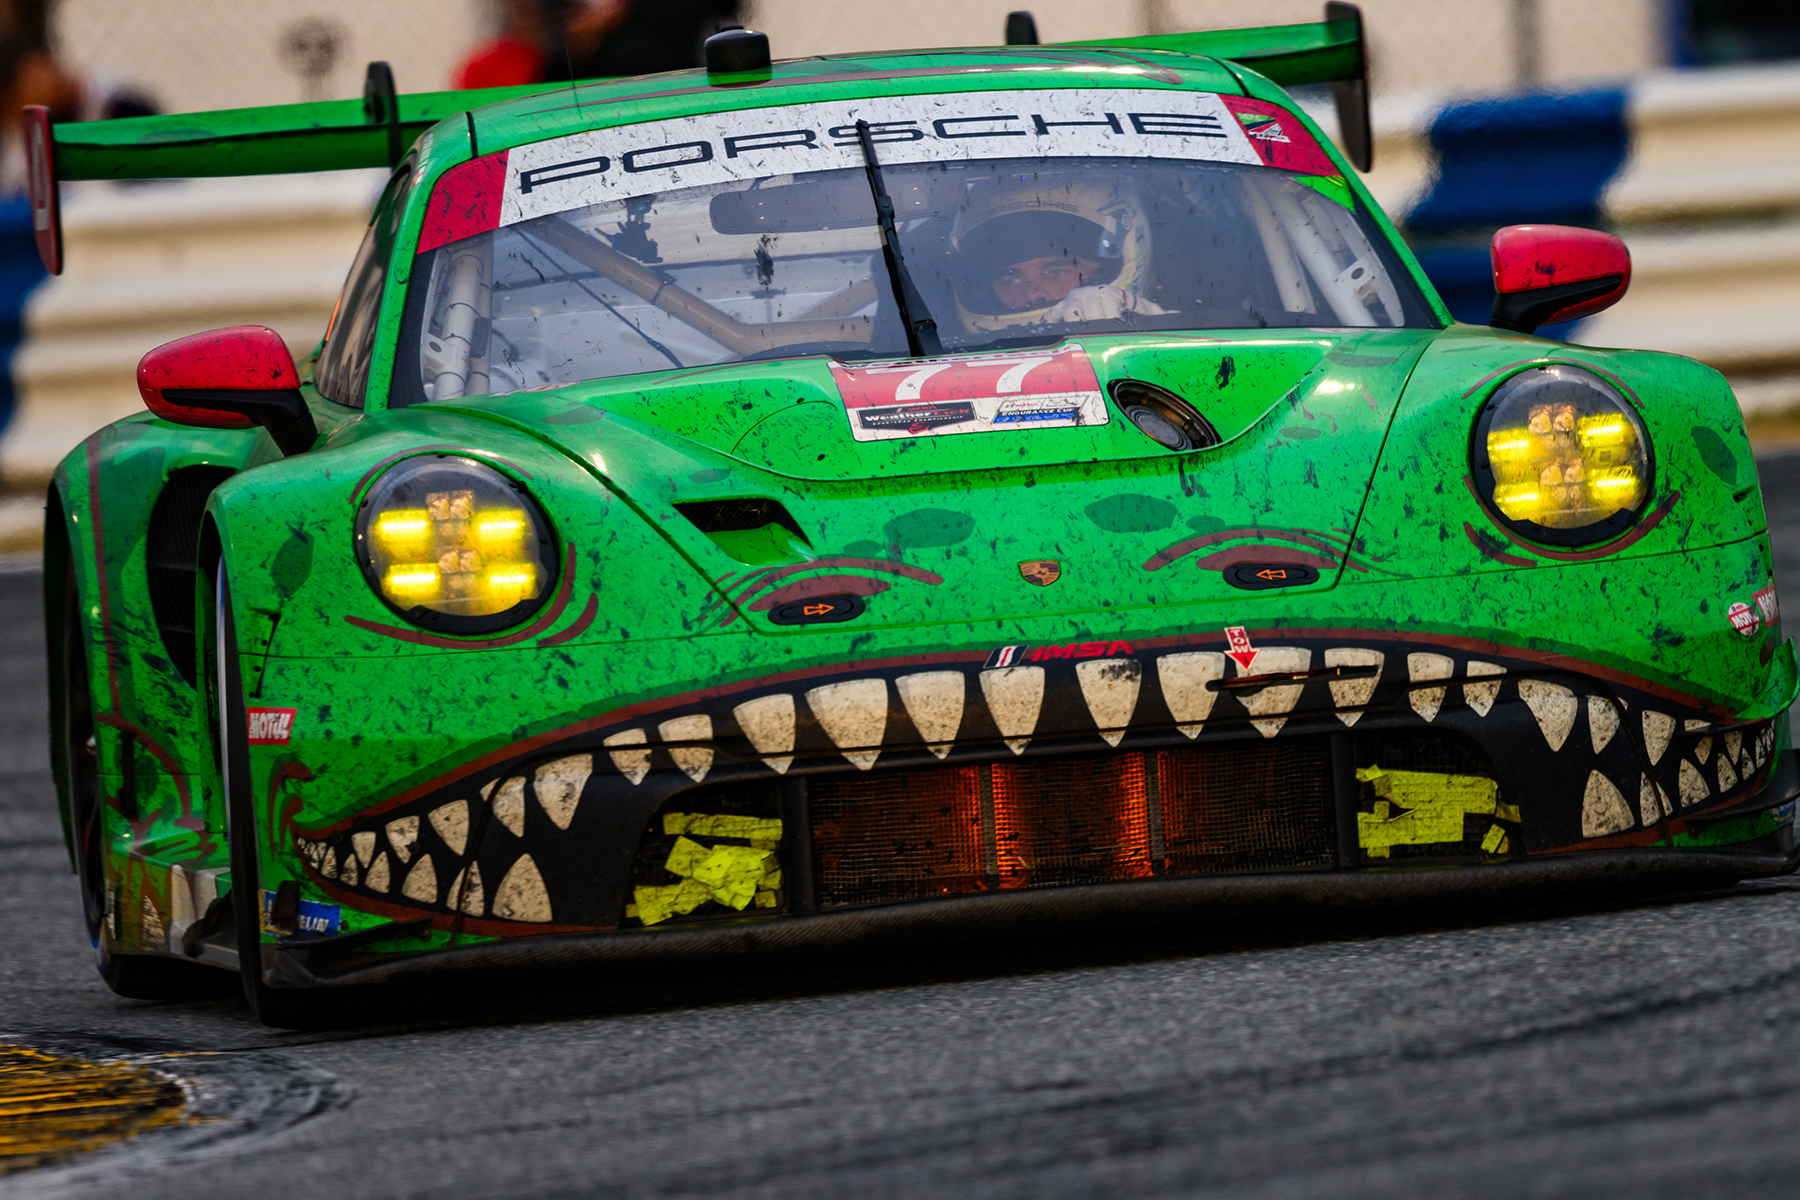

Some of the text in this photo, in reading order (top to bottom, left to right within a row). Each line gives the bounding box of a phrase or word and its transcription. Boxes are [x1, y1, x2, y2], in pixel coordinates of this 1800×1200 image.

[520, 112, 1228, 195] PORSCHE
[865, 356, 1053, 401] 77
[865, 408, 969, 422] WeatherTech
[1731, 611, 1760, 629] MOT
[1031, 639, 1135, 662] IMSA
[1230, 629, 1249, 654] TOW
[249, 712, 292, 739] MOTUL
